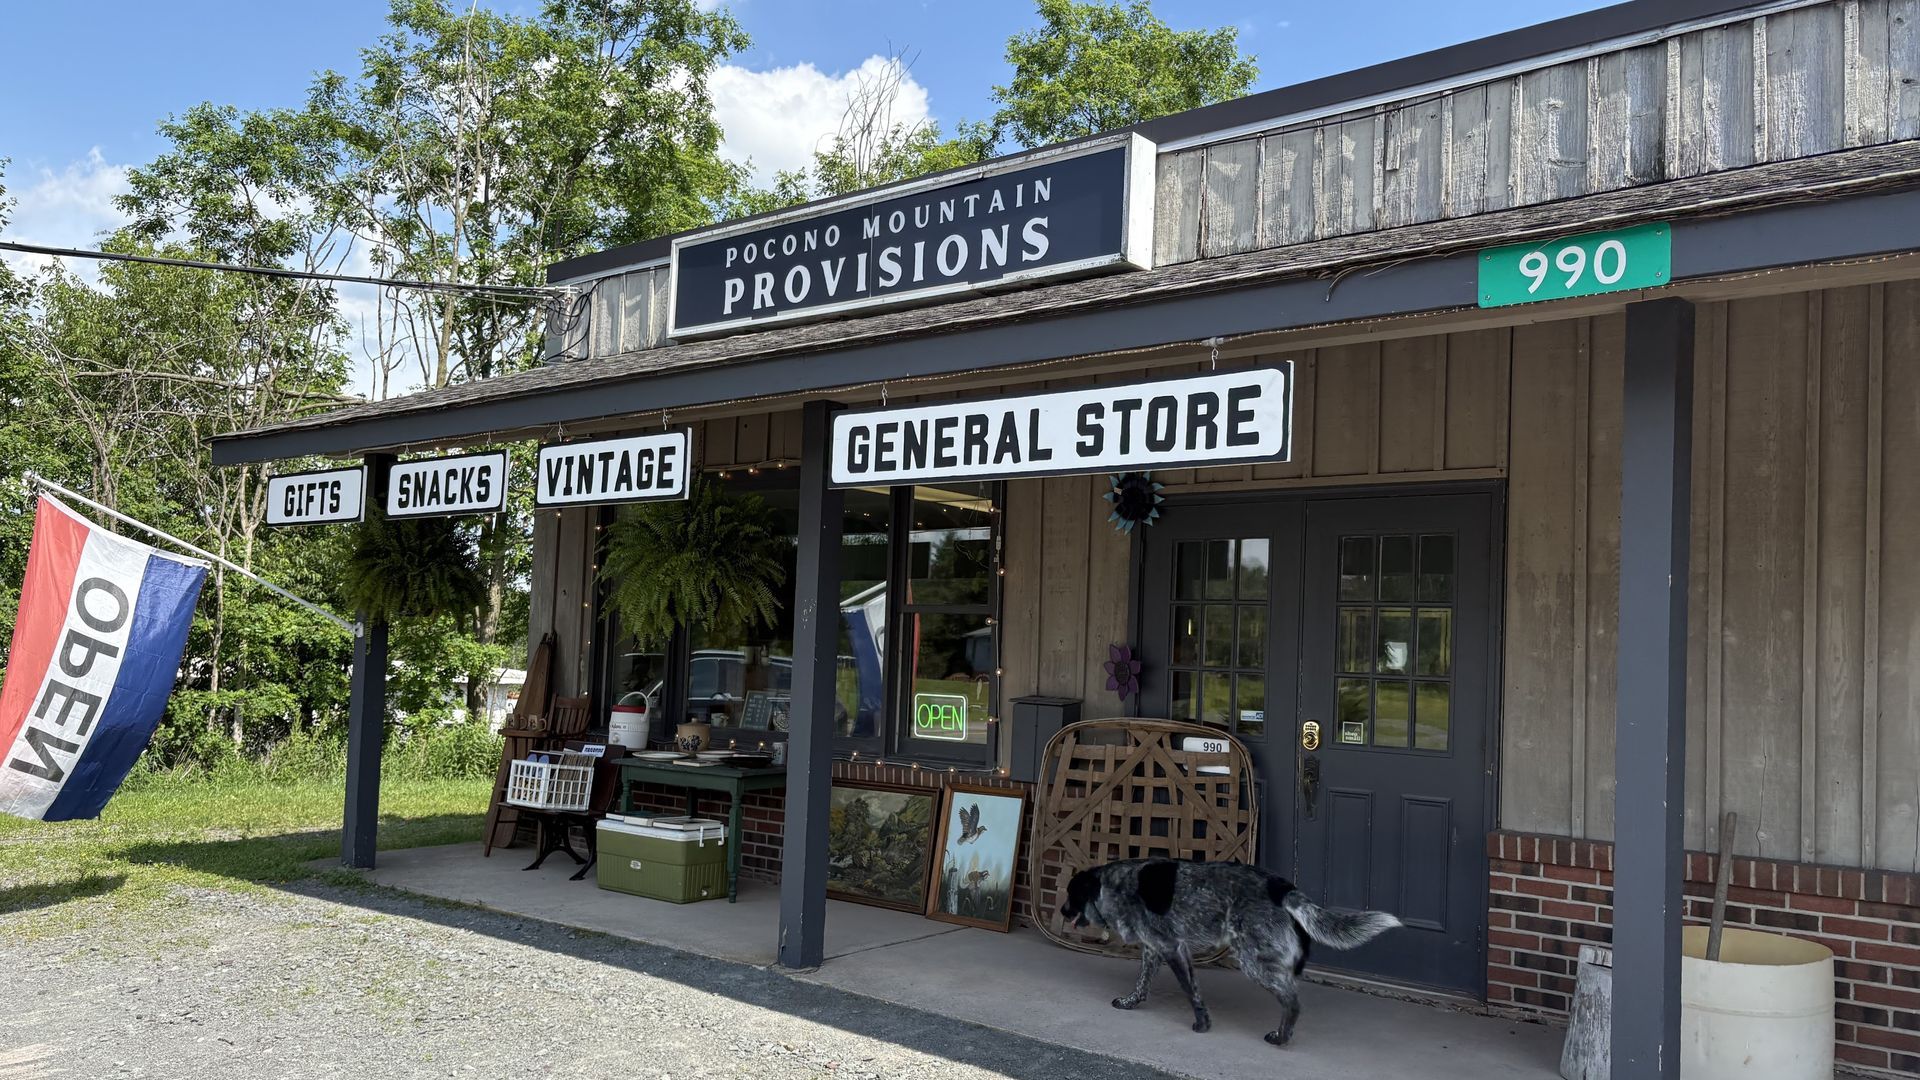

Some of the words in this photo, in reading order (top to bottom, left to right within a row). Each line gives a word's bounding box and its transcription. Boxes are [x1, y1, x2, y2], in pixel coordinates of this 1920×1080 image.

[725, 224, 841, 269] POCONO
[862, 176, 1052, 240] MOUNTAIN
[723, 216, 1050, 316] PROVISIONS
[1518, 239, 1627, 295] 990
[846, 407, 1053, 474] GENERAL
[1075, 384, 1262, 458] STORE
[398, 464, 492, 509] SNACKS
[545, 445, 677, 497] VINTAGE
[283, 479, 343, 518] GIFTS
[917, 703, 963, 731] OPEN
[1203, 741, 1222, 752] 990
